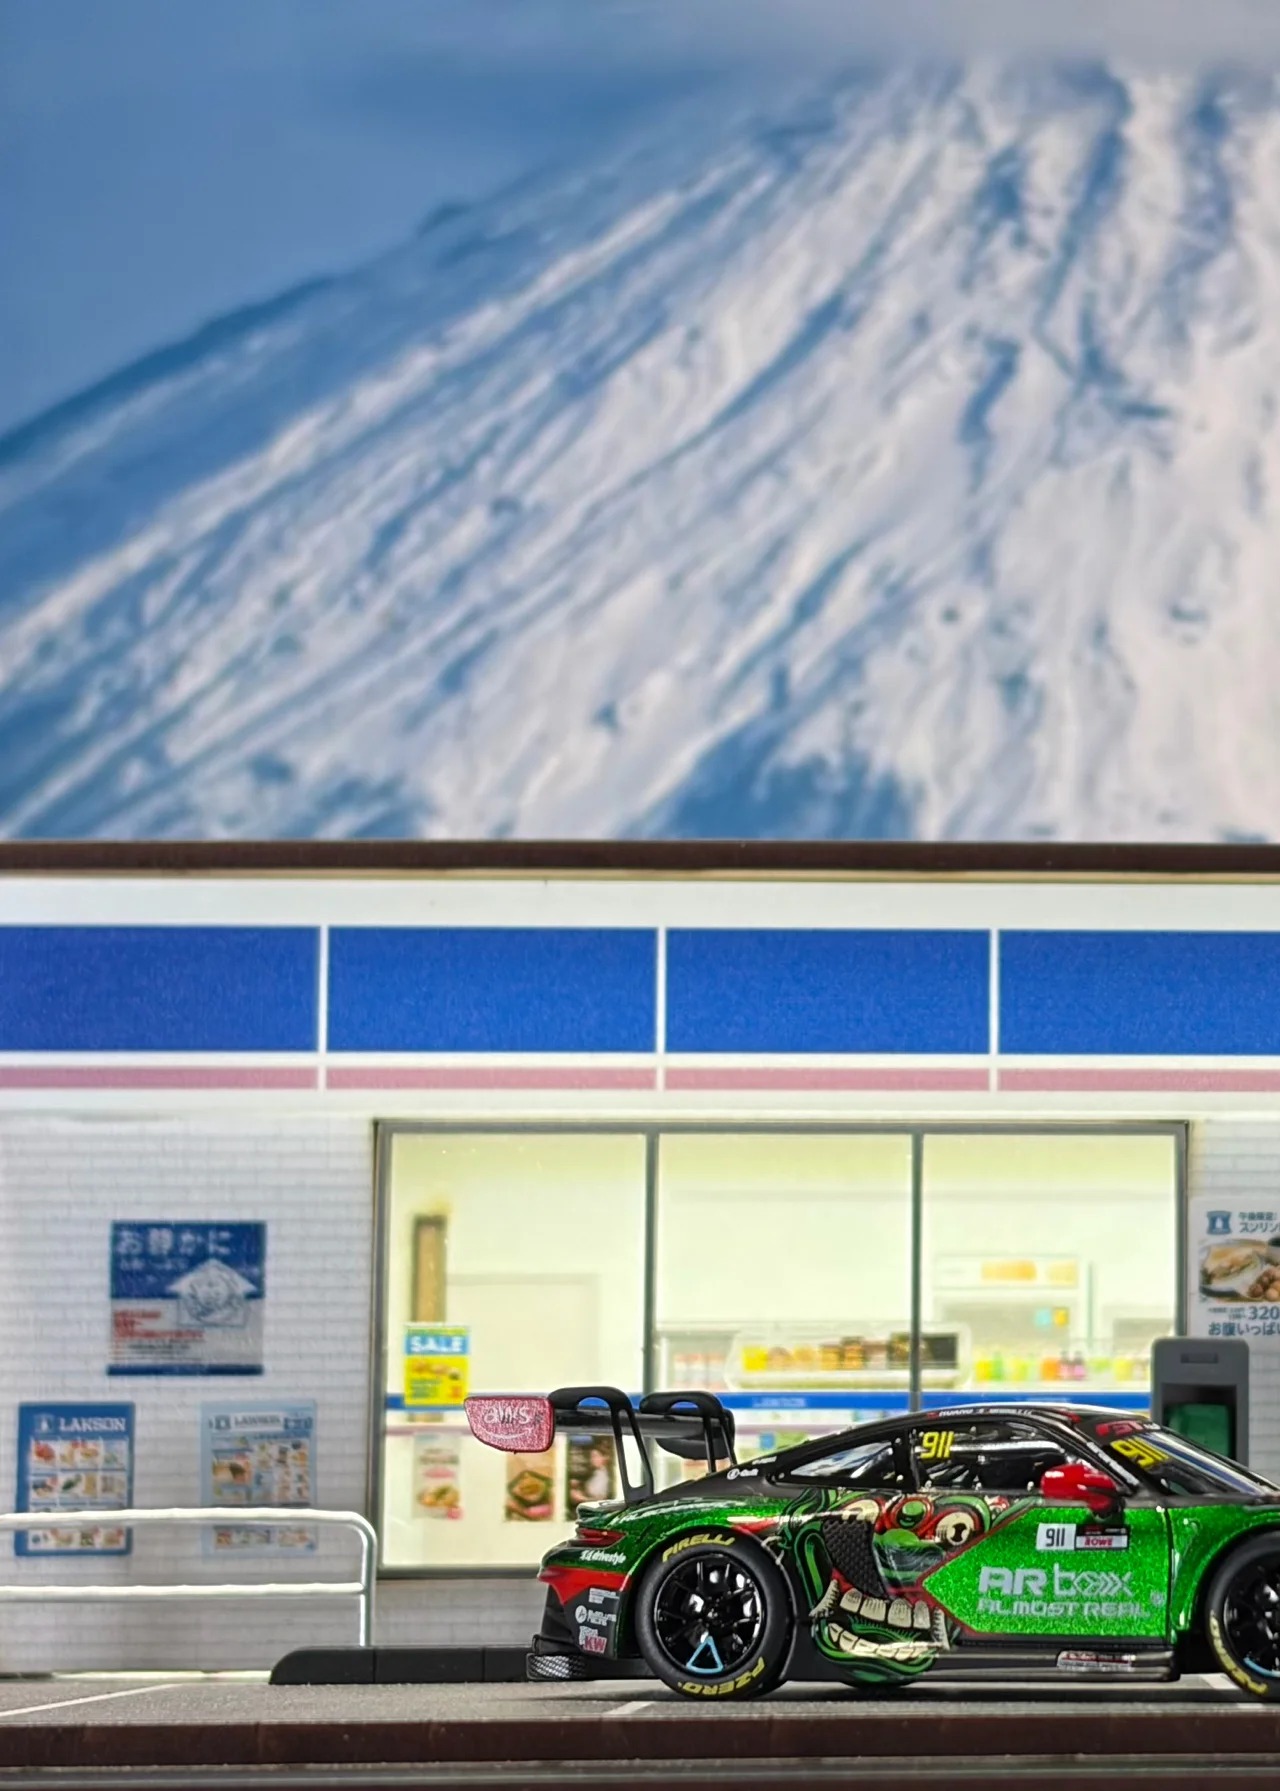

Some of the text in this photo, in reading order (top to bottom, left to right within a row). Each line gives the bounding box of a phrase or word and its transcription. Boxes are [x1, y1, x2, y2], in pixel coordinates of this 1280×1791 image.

[410, 1335, 465, 1352] SALE
[920, 1431, 955, 1460] 911
[1110, 1436, 1170, 1468] 911
[662, 1533, 735, 1563] PIRELLI
[1045, 1528, 1066, 1547] 911
[978, 1566, 1048, 1596] AR
